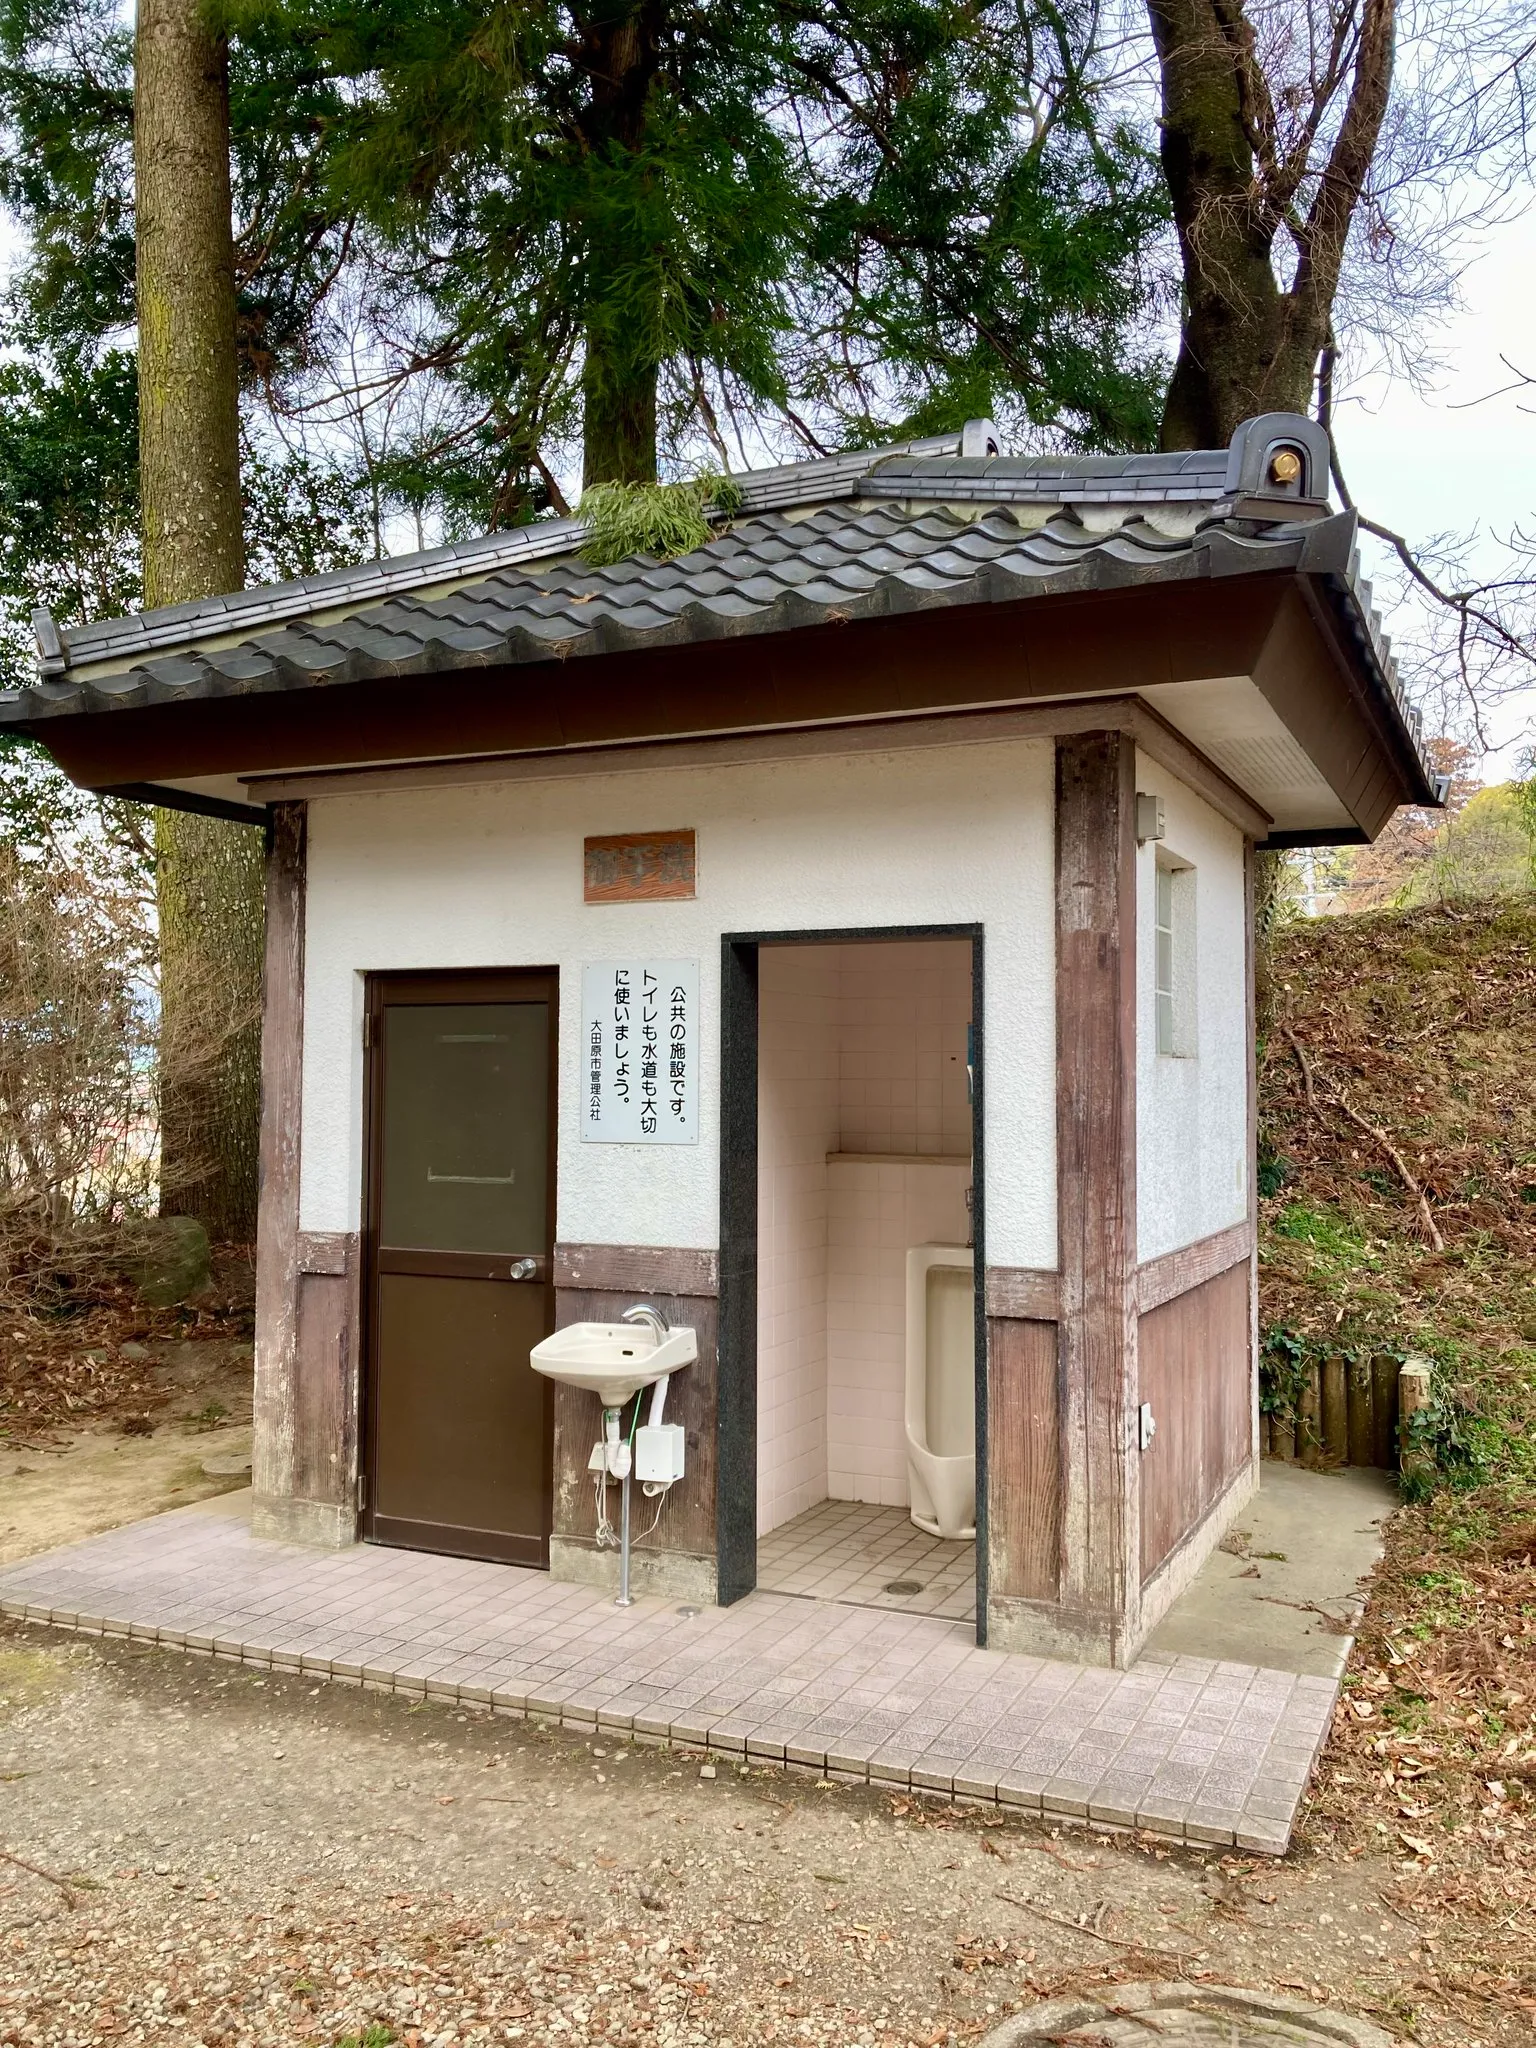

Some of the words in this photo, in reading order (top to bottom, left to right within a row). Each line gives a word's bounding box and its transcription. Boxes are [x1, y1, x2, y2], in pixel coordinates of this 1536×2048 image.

[589, 1019, 602, 1121] 大田原市管理公社
[613, 969, 631, 1104] に使いましょう。
[640, 969, 658, 1134] トイレも水道も大切
[669, 986, 687, 1123] 公共の施設です。
